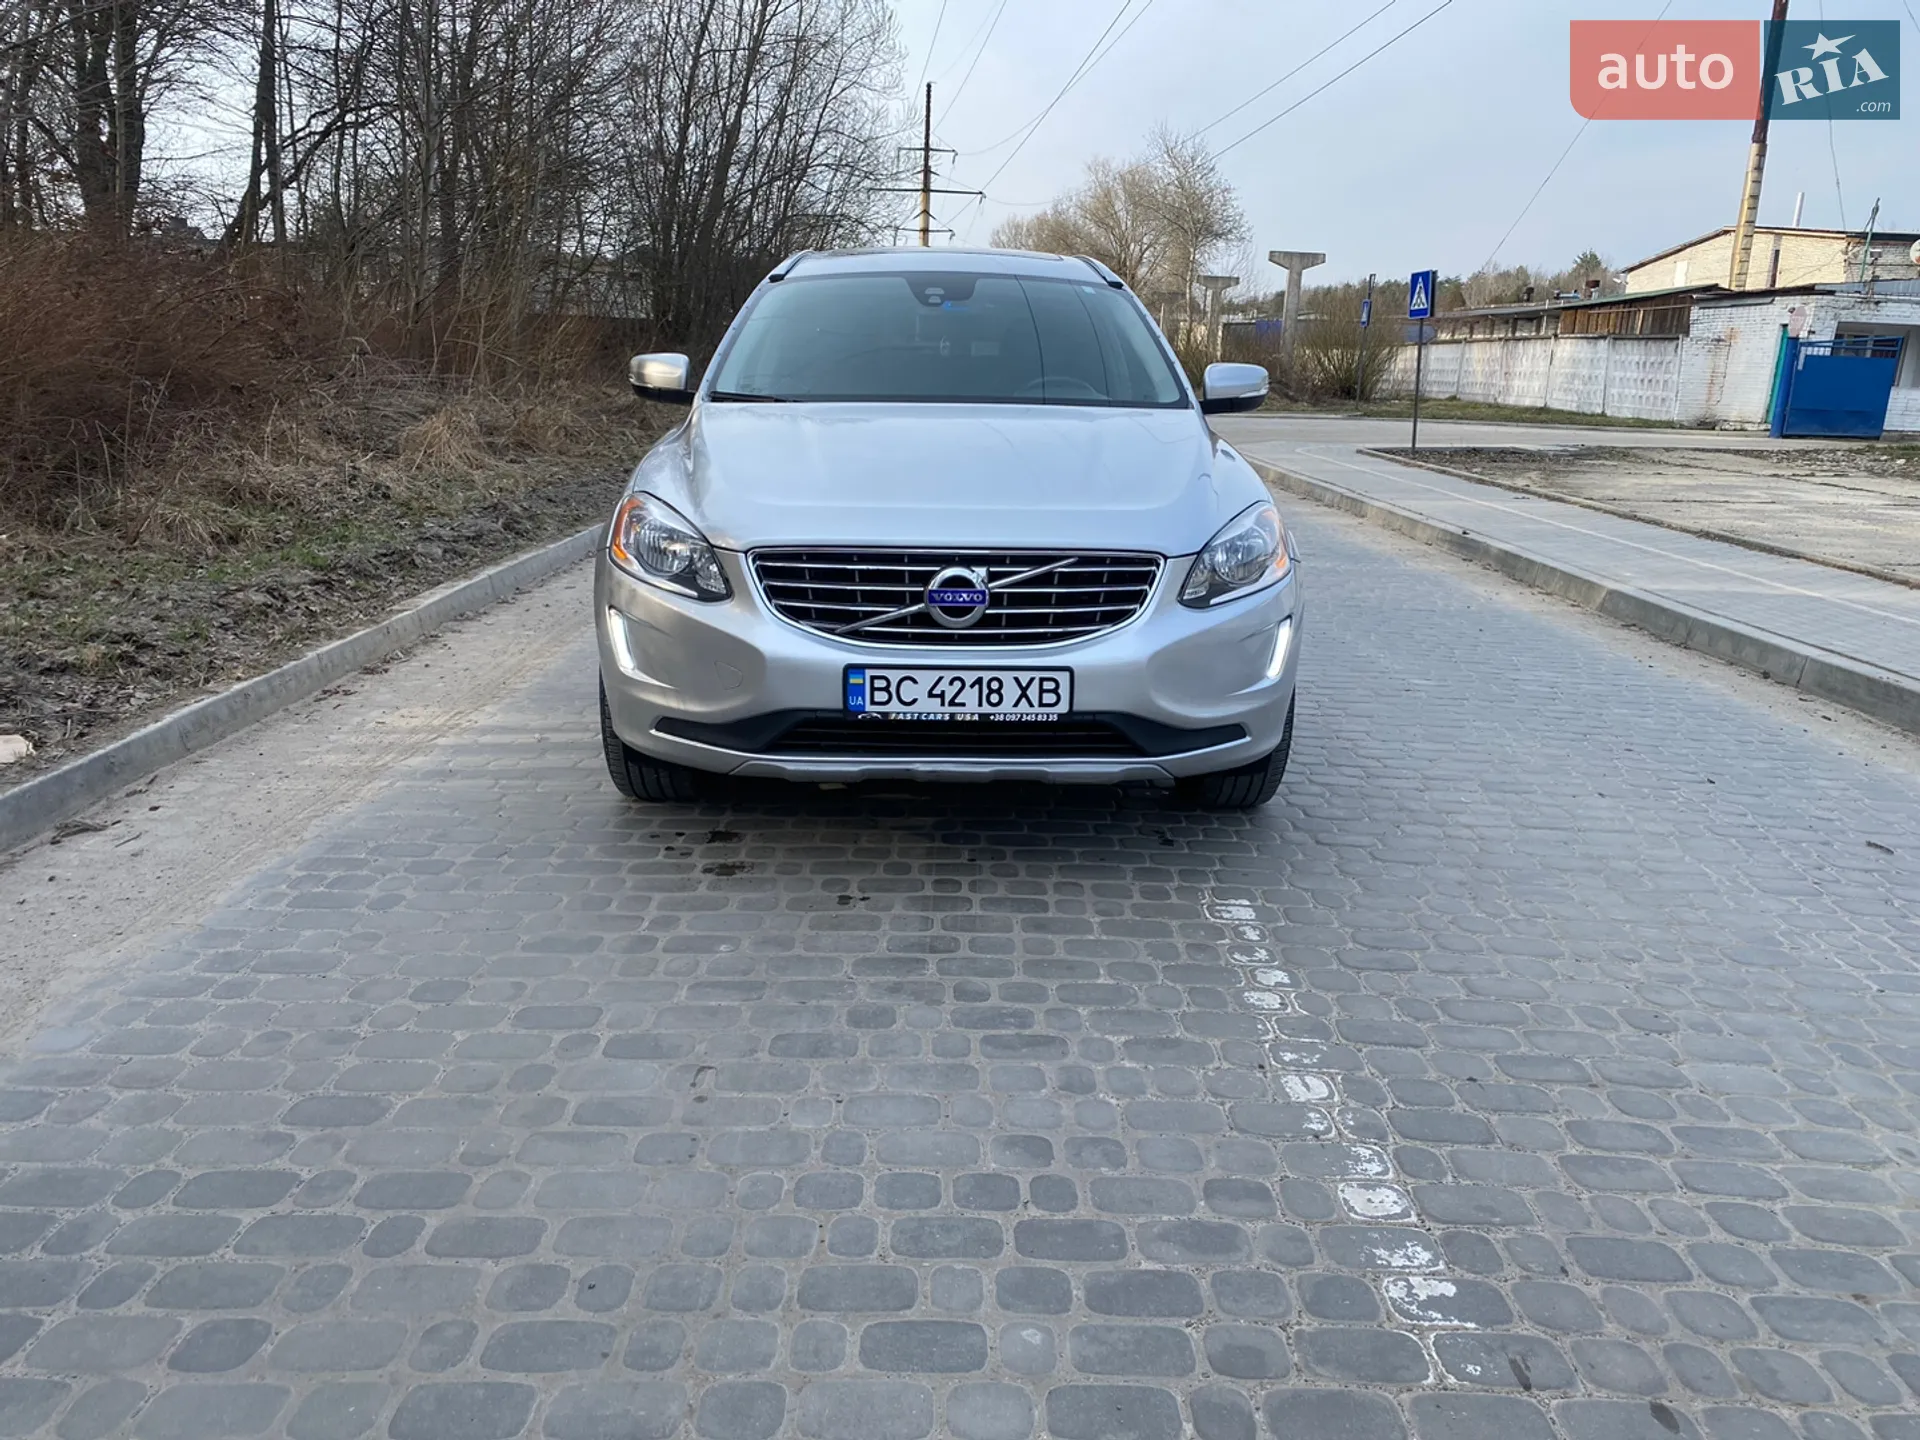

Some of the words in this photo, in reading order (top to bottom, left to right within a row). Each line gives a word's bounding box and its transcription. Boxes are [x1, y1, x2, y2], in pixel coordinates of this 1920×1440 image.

[931, 592, 983, 602] VOLVO
[869, 675, 919, 707] BC
[927, 676, 1004, 708] 4218
[1012, 676, 1062, 708] XB
[849, 695, 864, 706] UA
[921, 713, 950, 721] CARS
[956, 713, 979, 721] USA
